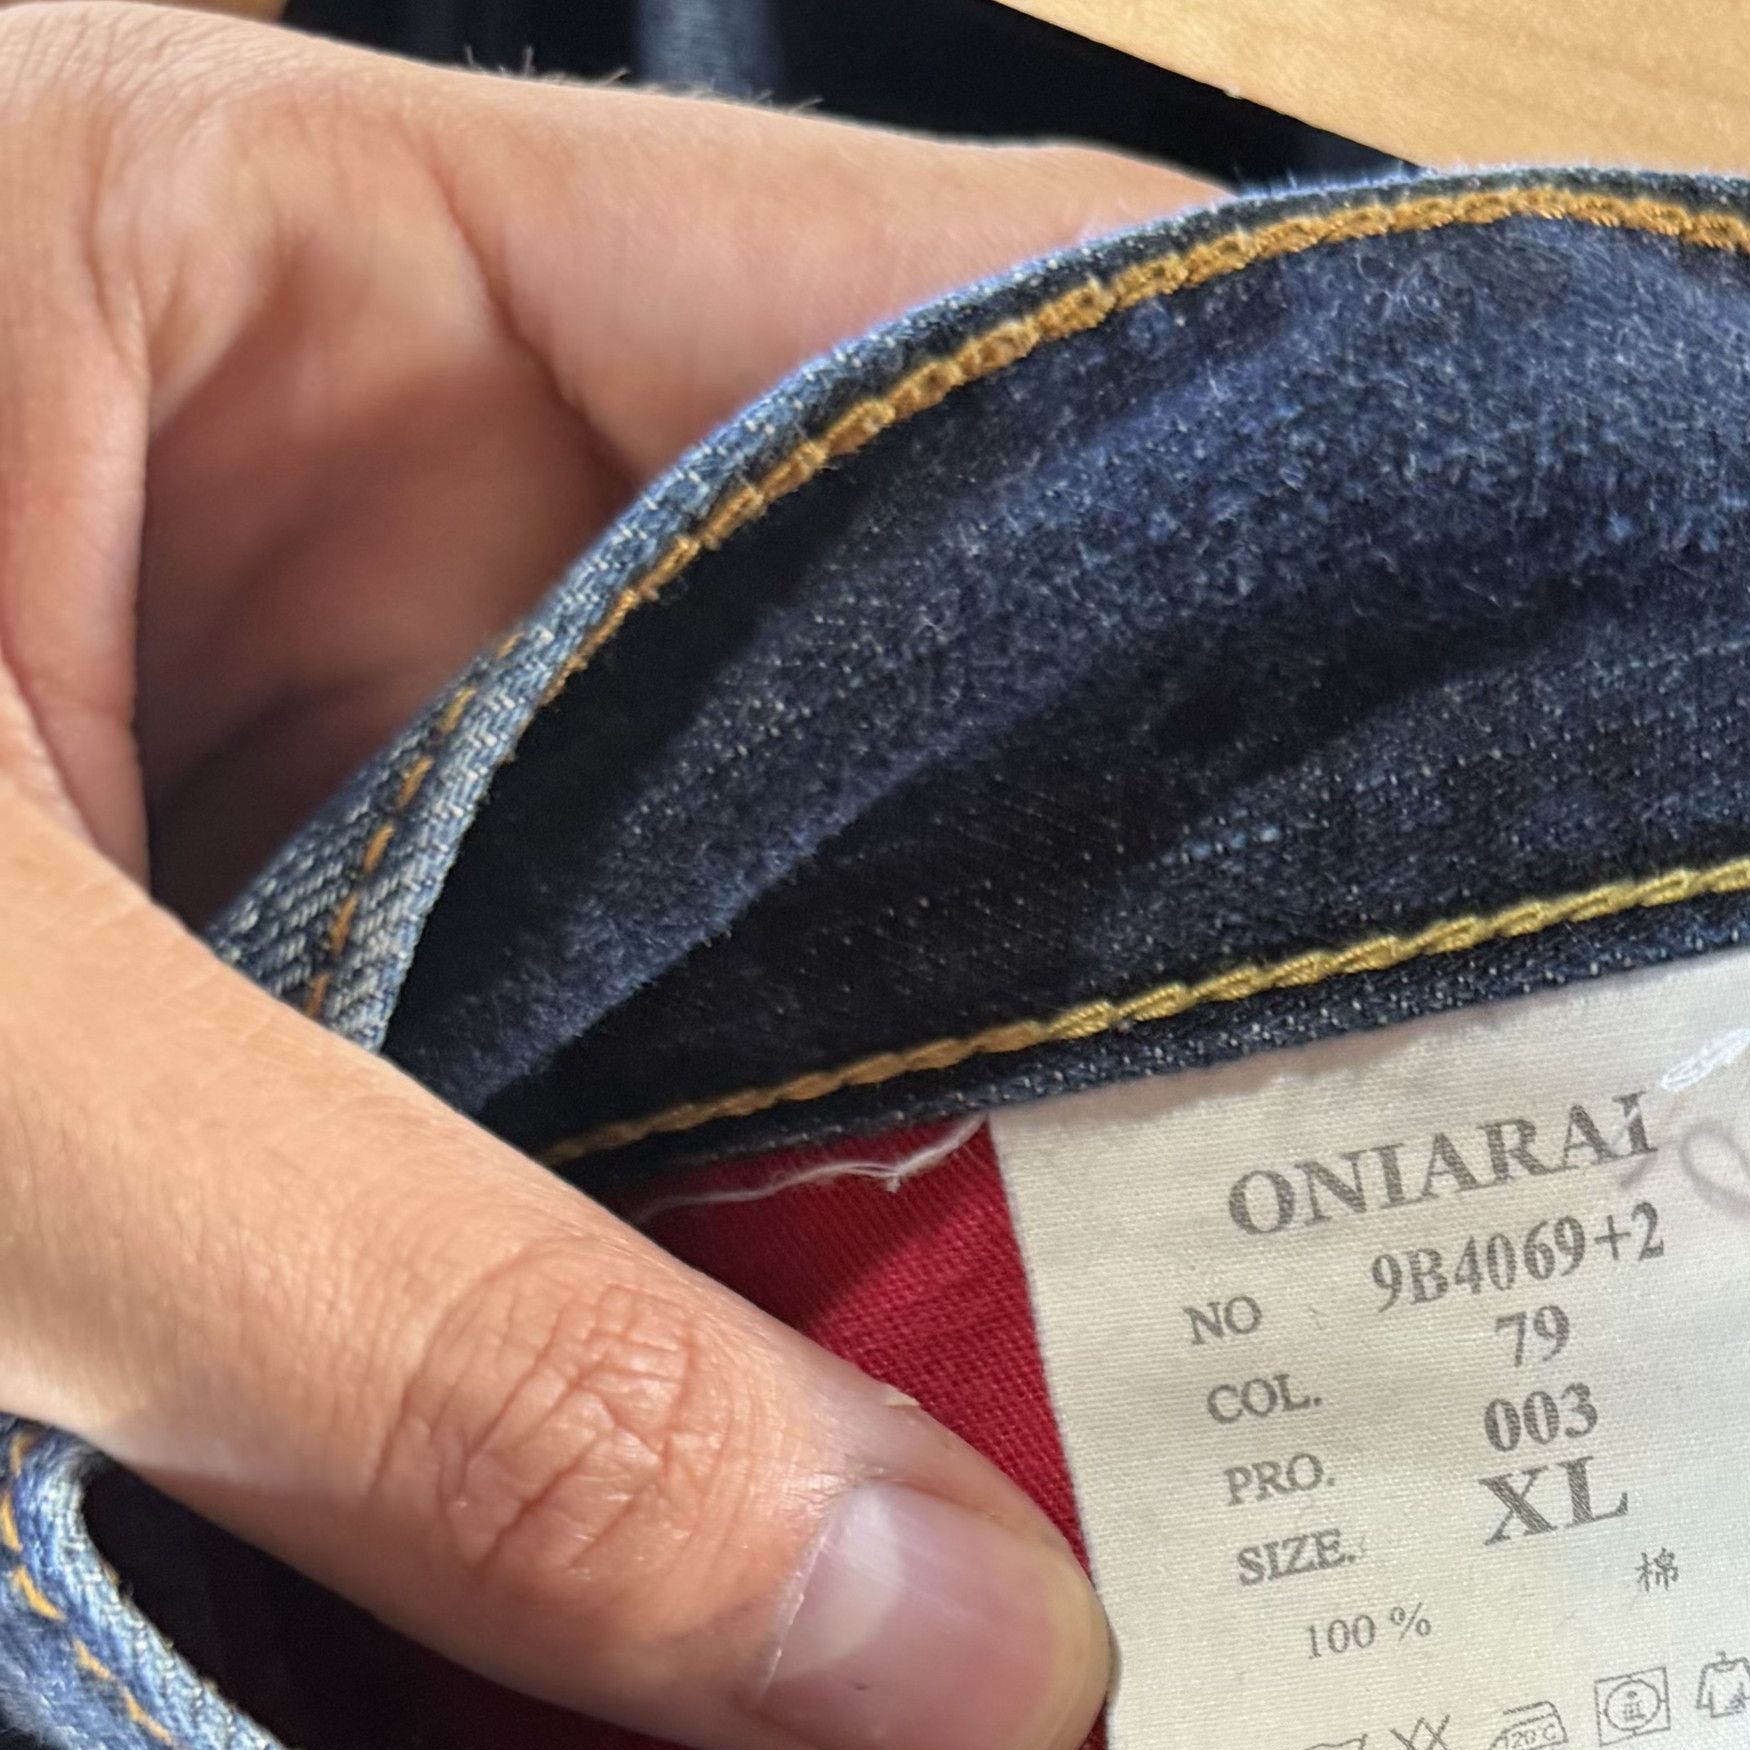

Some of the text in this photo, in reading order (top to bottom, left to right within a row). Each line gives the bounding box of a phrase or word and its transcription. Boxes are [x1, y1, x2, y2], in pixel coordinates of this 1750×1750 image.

[1228, 1090, 1658, 1235] ONIARAI
[1183, 1200, 1665, 1345] NO 9B4069+2
[1206, 1304, 1570, 1424] COL. 79
[1223, 1382, 1598, 1506] PRO. 003
[1236, 1455, 1628, 1586] SIZE. XL
[1307, 1613, 1376, 1660] 100
